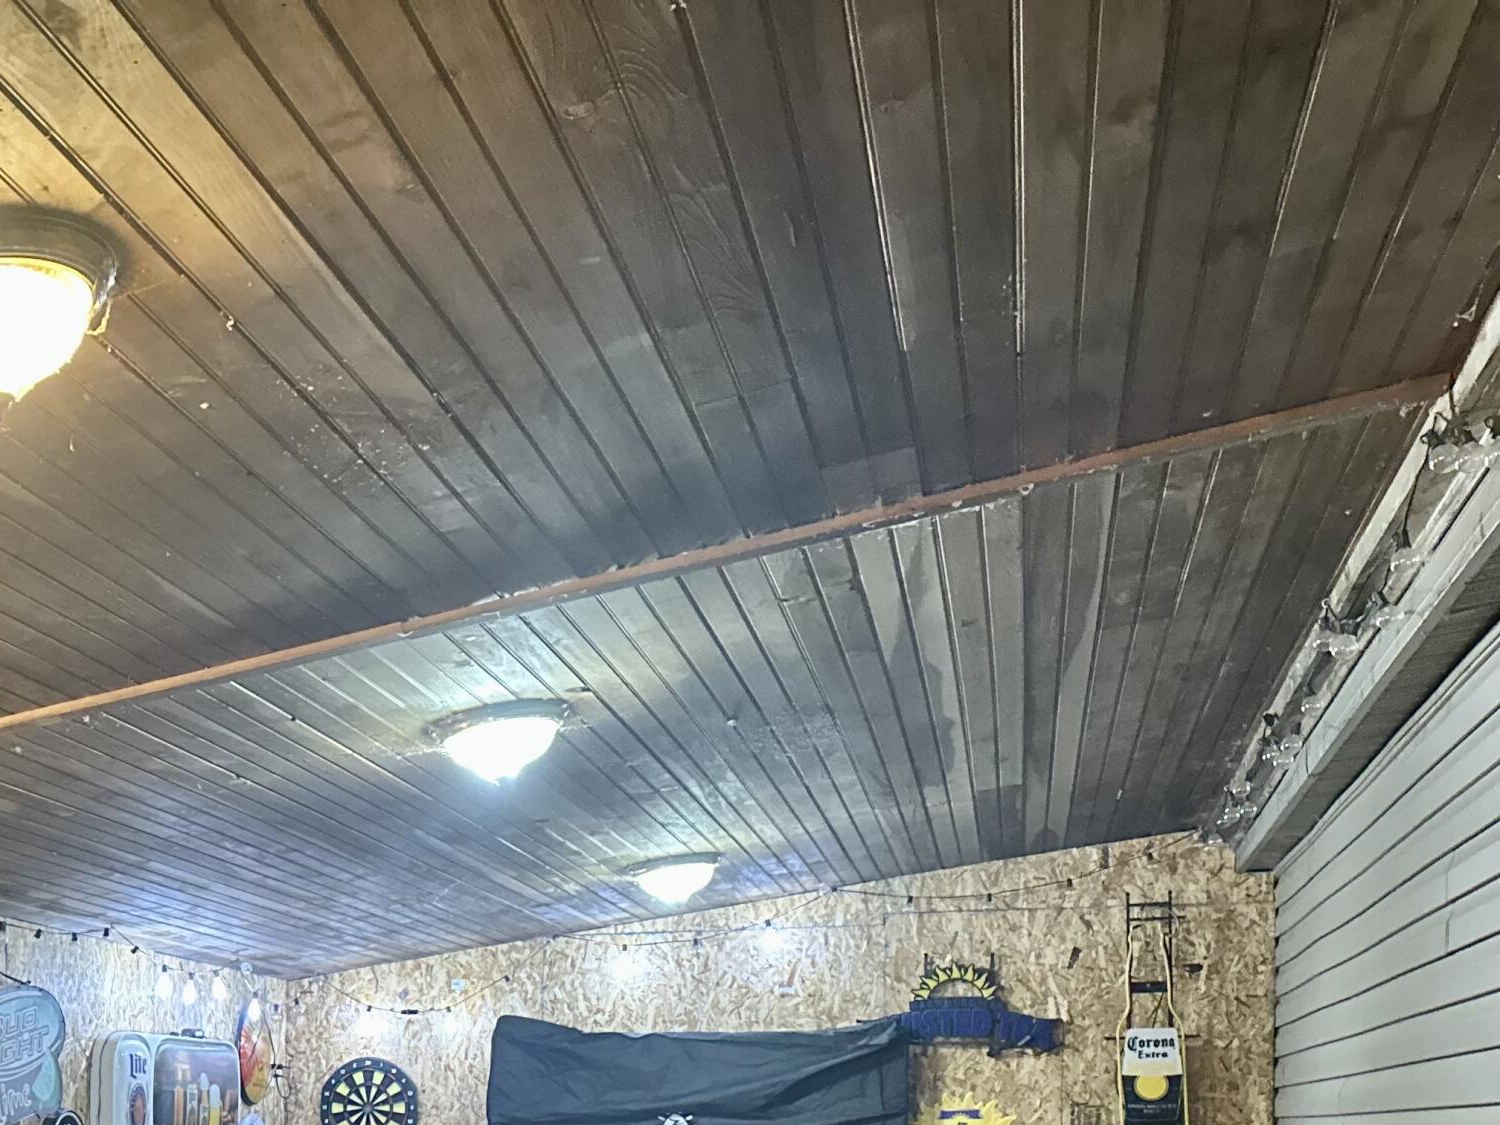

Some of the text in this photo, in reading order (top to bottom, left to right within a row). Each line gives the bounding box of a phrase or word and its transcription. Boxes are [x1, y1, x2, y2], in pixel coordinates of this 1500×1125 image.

[902, 1008, 992, 1038] ISTED
[1127, 1036, 1175, 1051] Corona
[1138, 1050, 1169, 1059] Extra
[129, 1053, 148, 1079] Lite
